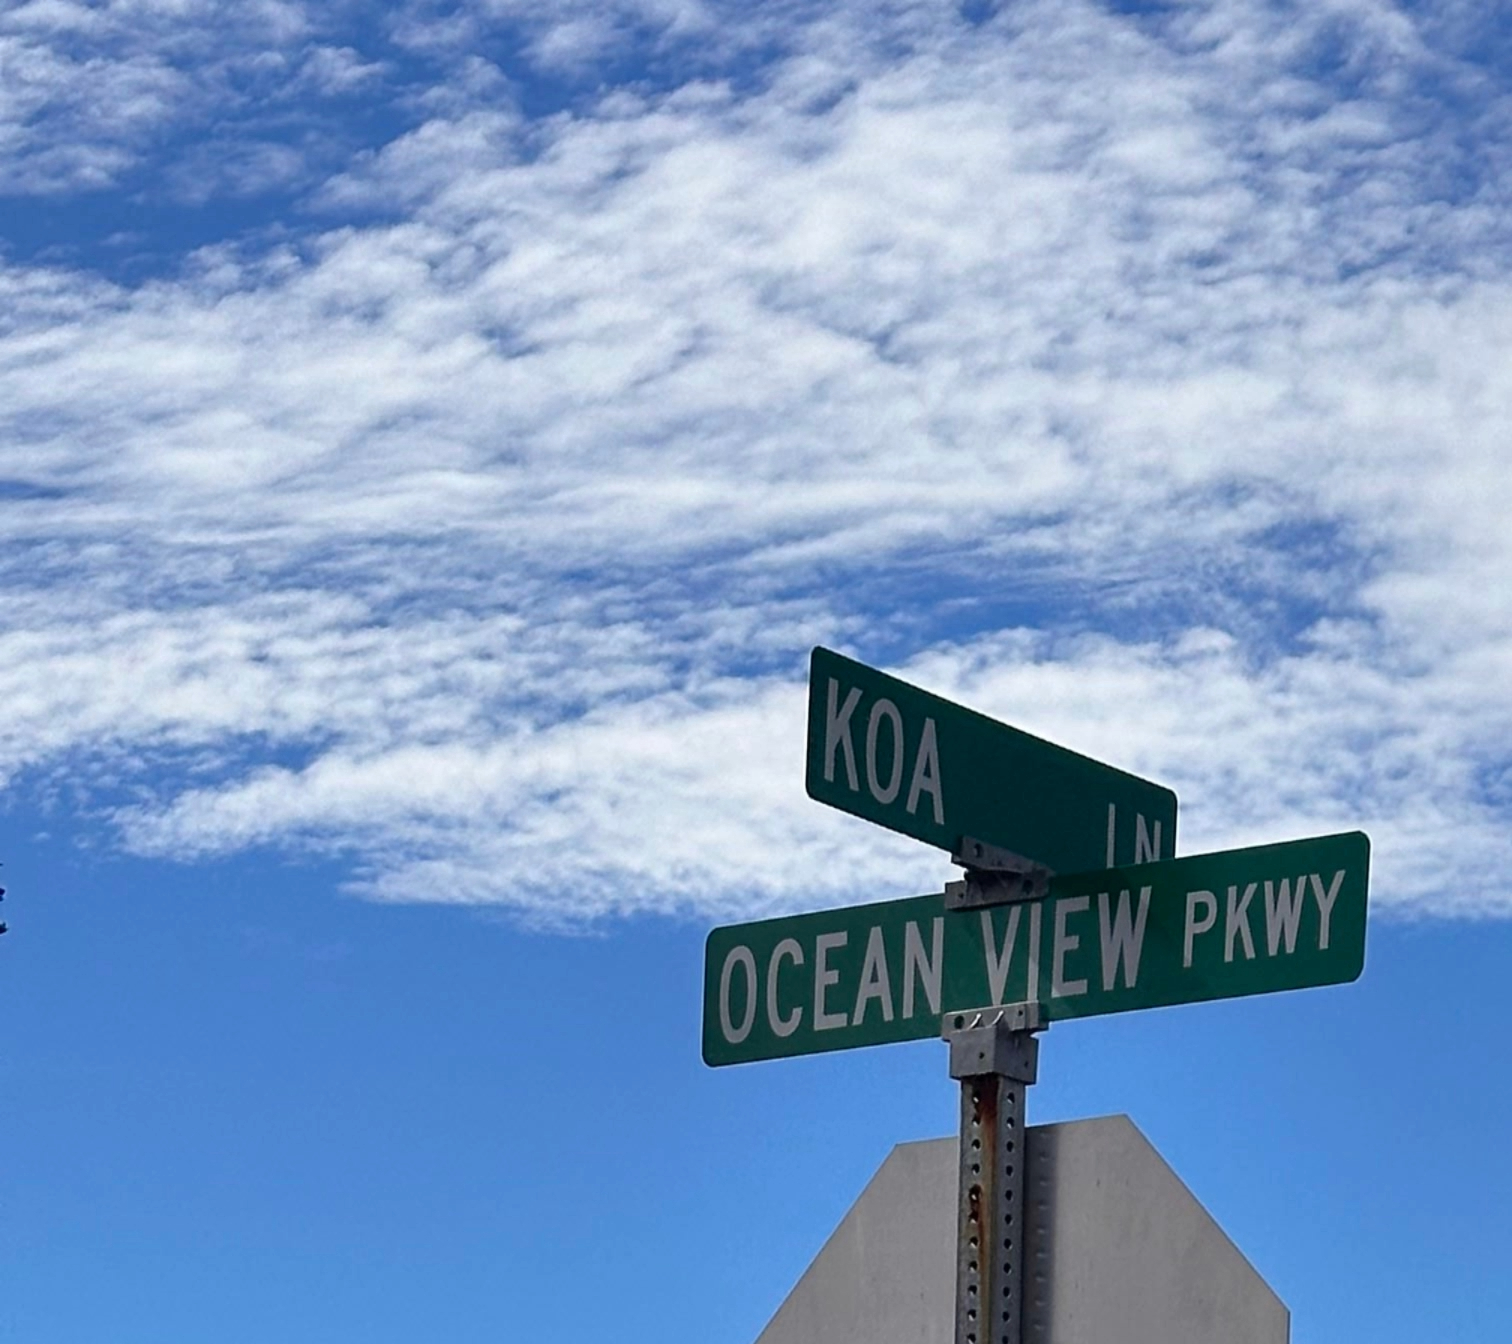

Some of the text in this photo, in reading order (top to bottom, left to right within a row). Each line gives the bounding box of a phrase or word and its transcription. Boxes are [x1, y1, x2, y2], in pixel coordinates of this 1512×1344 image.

[824, 677, 944, 825] KOA
[719, 870, 1346, 1044] OCEAN VIEW PKWY
